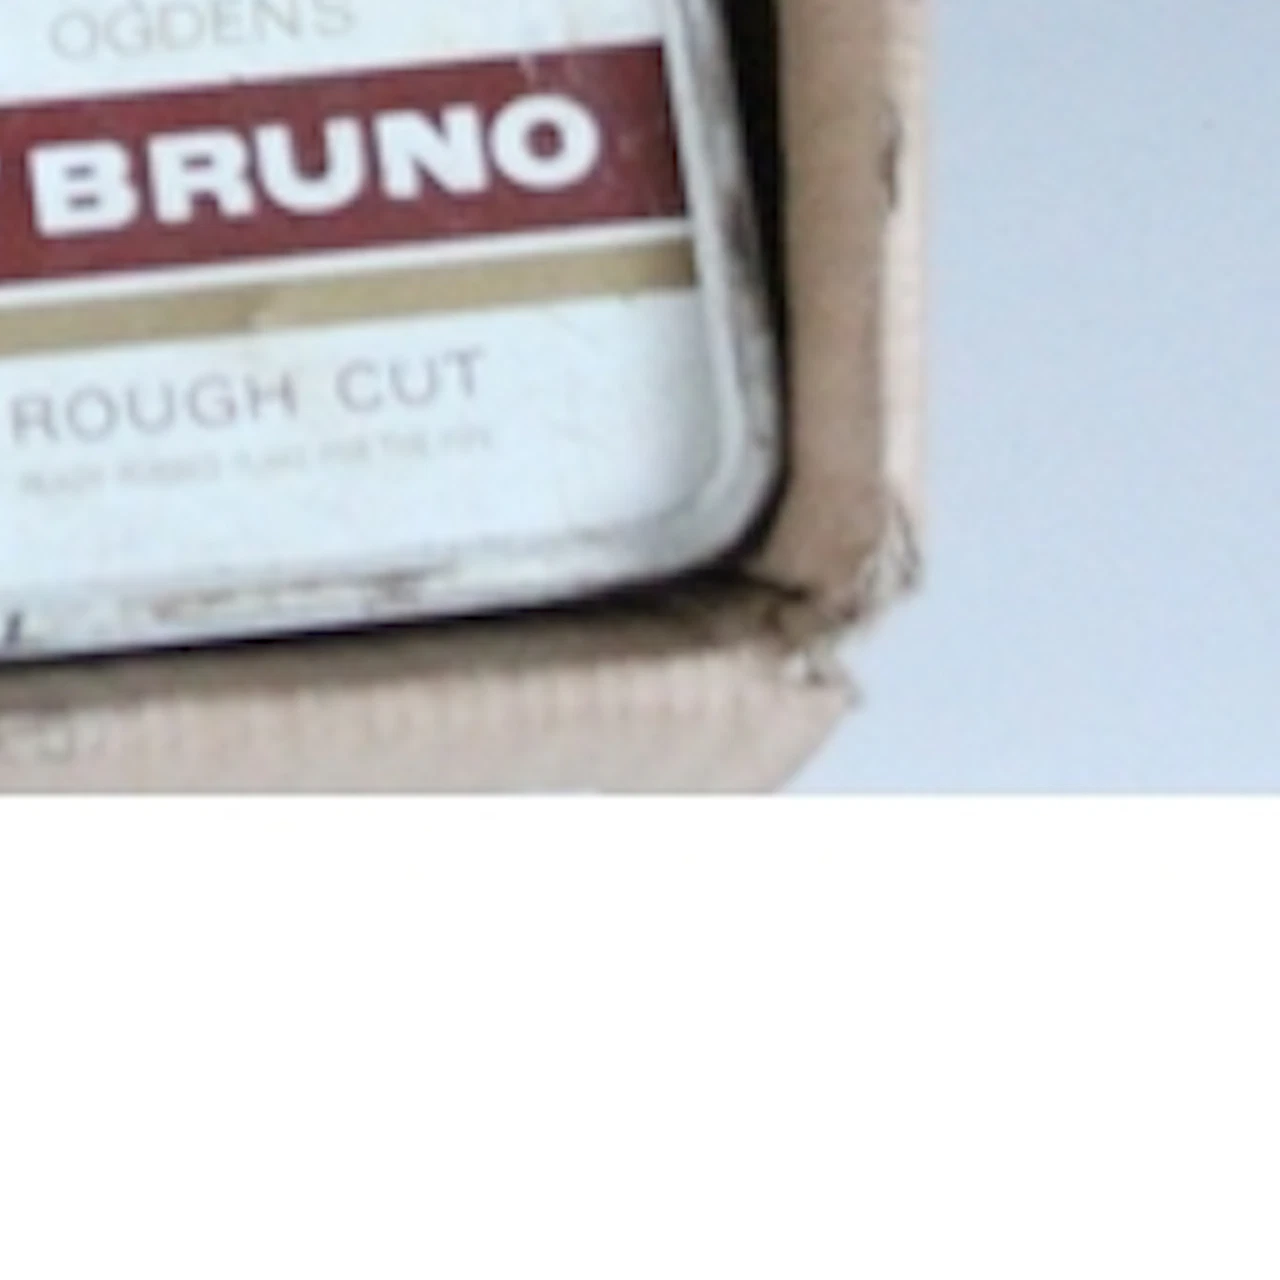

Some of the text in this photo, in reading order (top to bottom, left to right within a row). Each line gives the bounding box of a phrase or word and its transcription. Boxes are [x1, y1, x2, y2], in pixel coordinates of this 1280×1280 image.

[28, 93, 602, 240] BRUNO
[10, 347, 487, 450] ROUGH CUT
